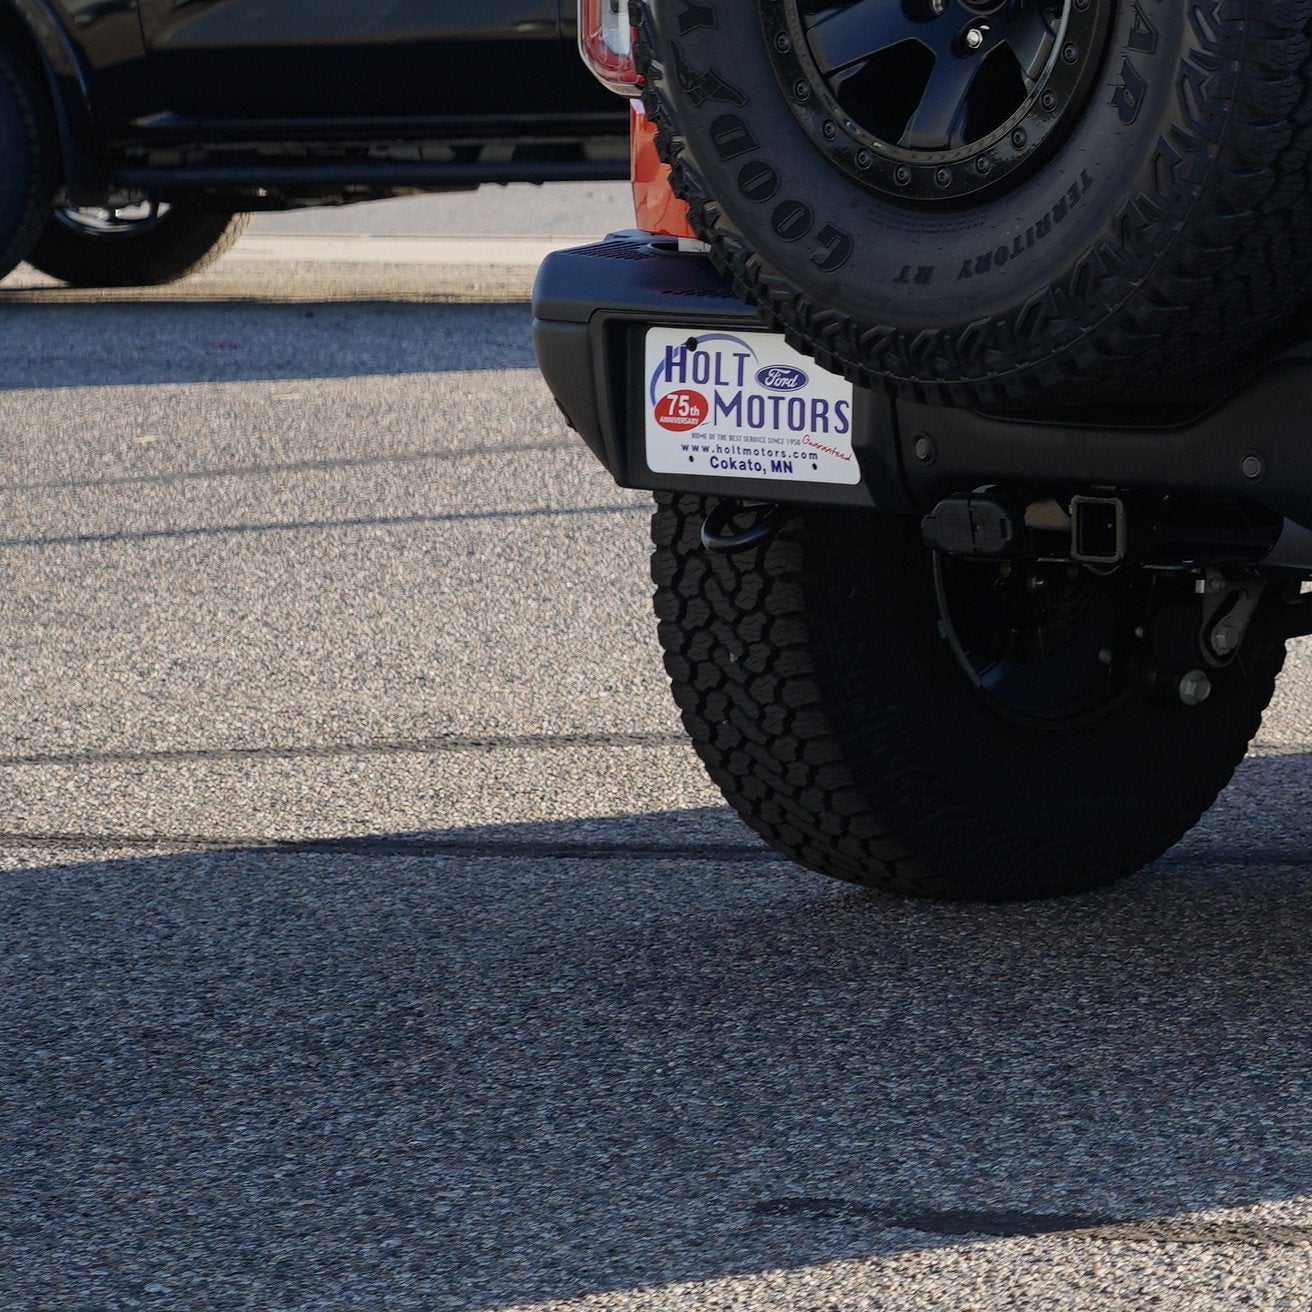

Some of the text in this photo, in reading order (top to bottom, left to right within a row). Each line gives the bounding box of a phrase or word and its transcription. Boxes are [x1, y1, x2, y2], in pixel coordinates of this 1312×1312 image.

[956, 167, 1094, 280] TERRITORY
[894, 265, 936, 285] RT
[665, 345, 751, 387] HOLT
[765, 368, 799, 388] Ford
[714, 388, 850, 435] MOTORS
[681, 444, 818, 460] www.holtmotors.com
[710, 455, 794, 474] Cokato, MN
